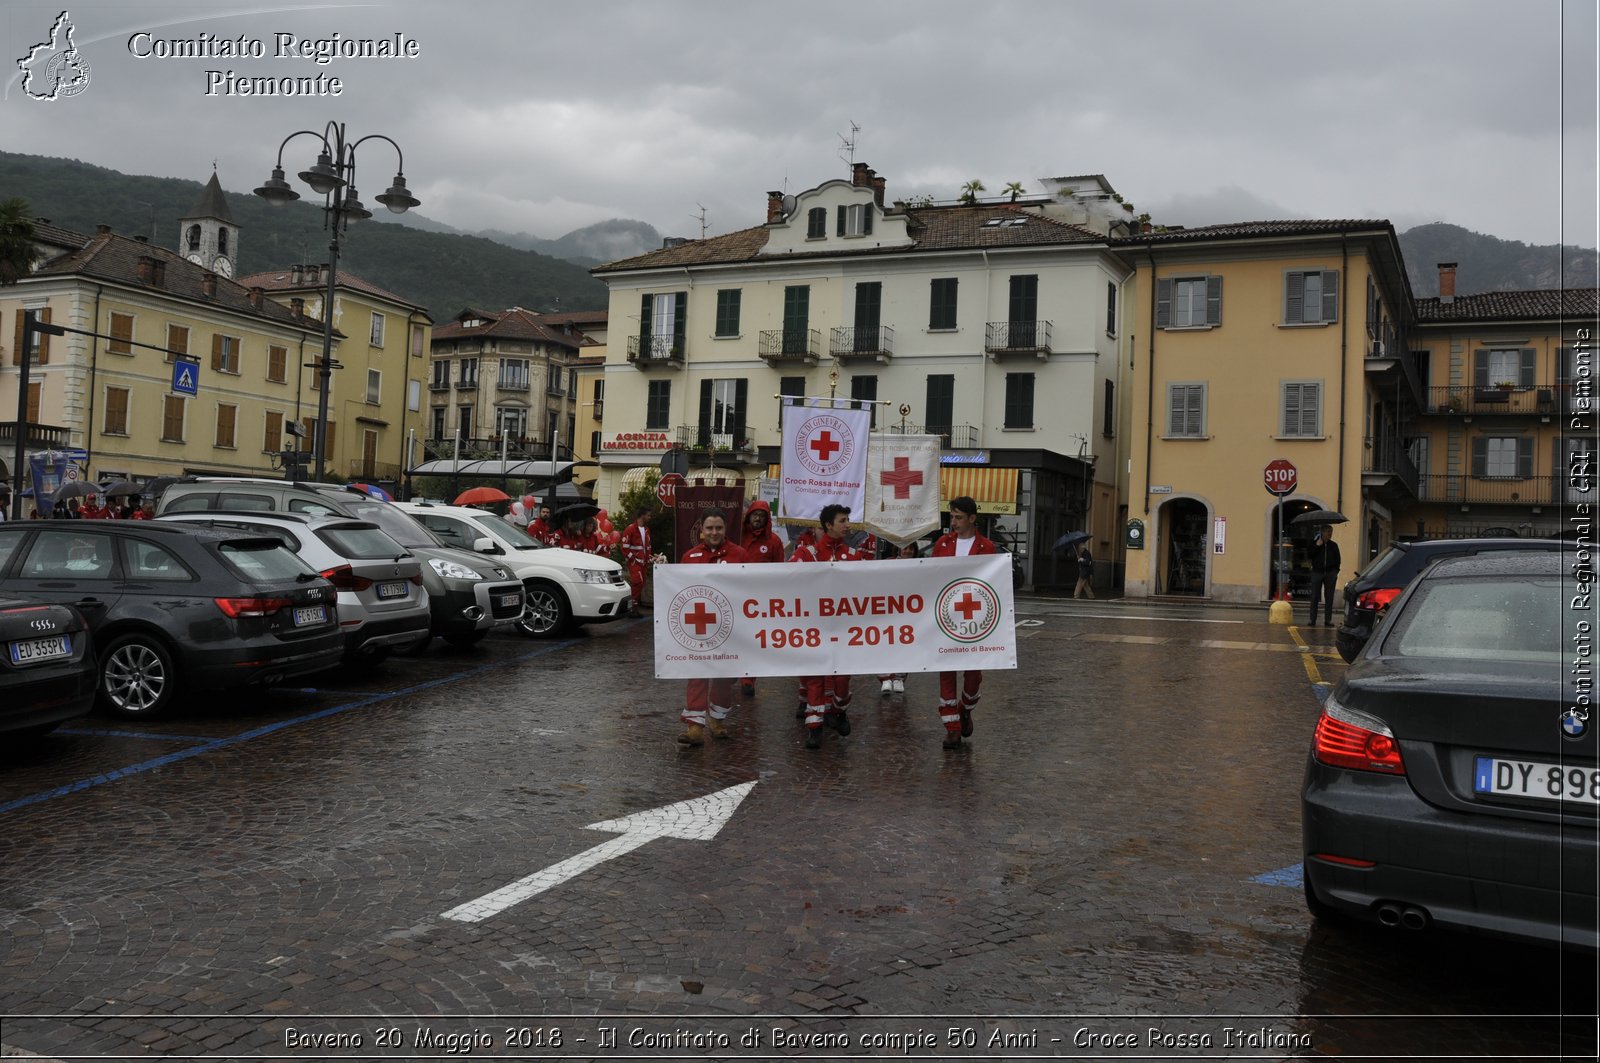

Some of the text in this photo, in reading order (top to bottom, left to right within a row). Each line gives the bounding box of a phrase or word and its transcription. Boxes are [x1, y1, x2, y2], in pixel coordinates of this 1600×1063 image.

[813, 417, 842, 430] GINEVRA
[616, 433, 667, 441] AGENZIA
[1266, 469, 1295, 482] STOP
[785, 478, 860, 489] Croce Rossa Italiana
[795, 486, 850, 496] Comitato di Baveno
[678, 501, 695, 509] CROCE
[678, 595, 687, 604] DI
[686, 587, 719, 602] GINEVRA
[717, 599, 726, 608] 22
[742, 594, 924, 619] C.R.I. BAVENO
[670, 602, 697, 648] CONVENZIONE
[719, 609, 731, 639] AGOSTO
[959, 621, 978, 636] 50
[754, 628, 821, 649] 1968
[847, 624, 915, 647] 2018
[688, 653, 711, 661] Rossa
